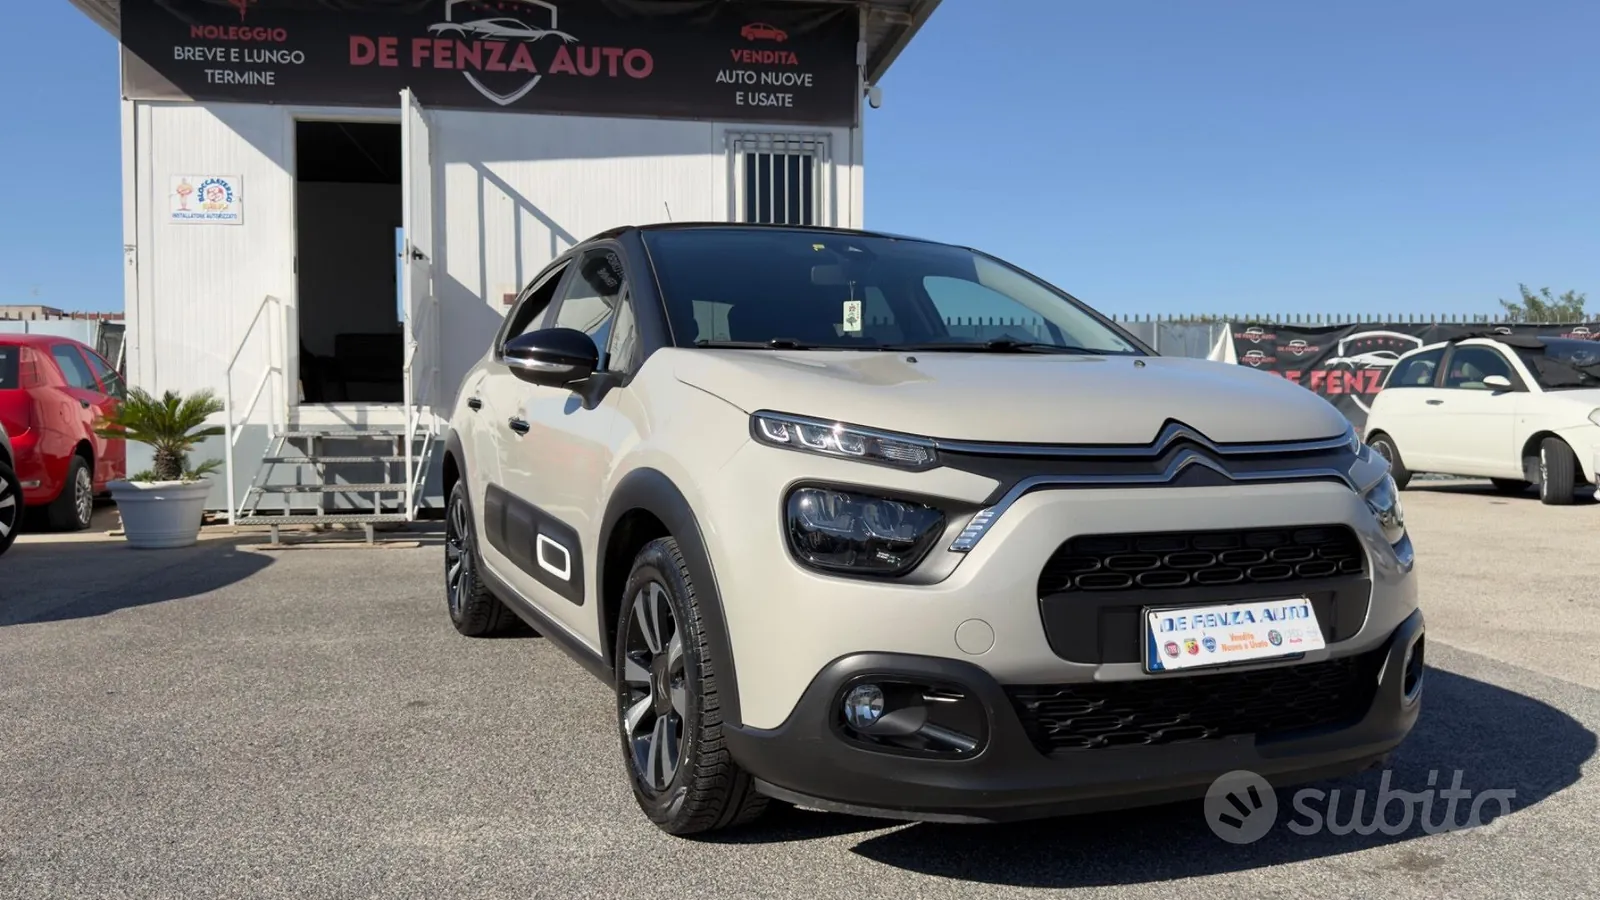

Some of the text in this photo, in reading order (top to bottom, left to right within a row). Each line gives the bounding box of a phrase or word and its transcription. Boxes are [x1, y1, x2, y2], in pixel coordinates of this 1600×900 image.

[191, 25, 287, 41] NOLEGGIO
[174, 46, 305, 64] BREVE E LUNGO
[349, 36, 654, 78] DE FENZA AUTO
[730, 49, 799, 65] VENDITA
[204, 69, 276, 85] TERMINE
[716, 69, 813, 87] AUTO NUOVE
[736, 91, 793, 107] E USATE
[1310, 370, 1382, 394] FENZ
[1160, 605, 1309, 632] DE FENZA AUTO
